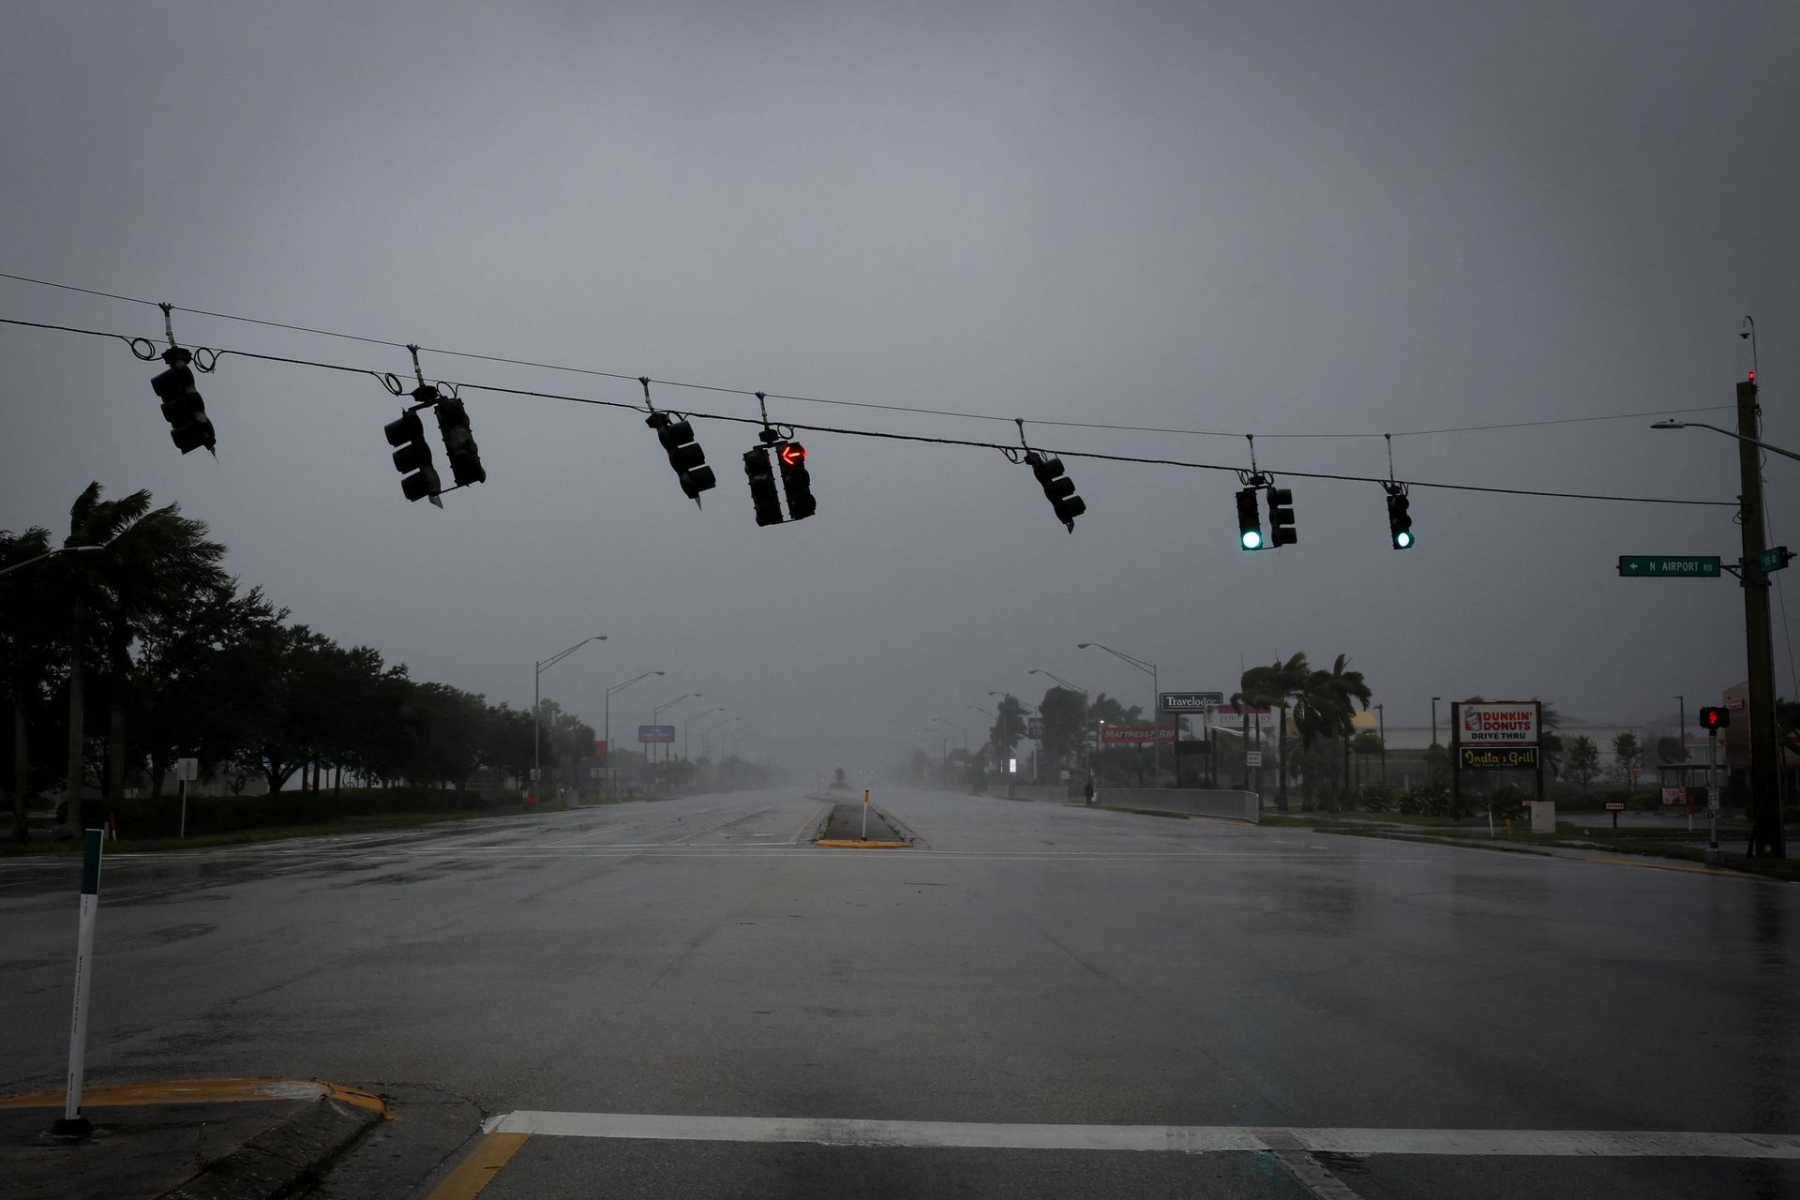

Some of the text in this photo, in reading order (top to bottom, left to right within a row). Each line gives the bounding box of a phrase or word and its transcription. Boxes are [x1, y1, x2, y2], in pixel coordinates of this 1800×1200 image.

[1649, 561, 1656, 571] N
[1662, 561, 1699, 571] AIRPORT
[1483, 712, 1532, 720] DUNKIN'
[1483, 722, 1530, 730] DONUTS
[1508, 748, 1534, 766] Grill
